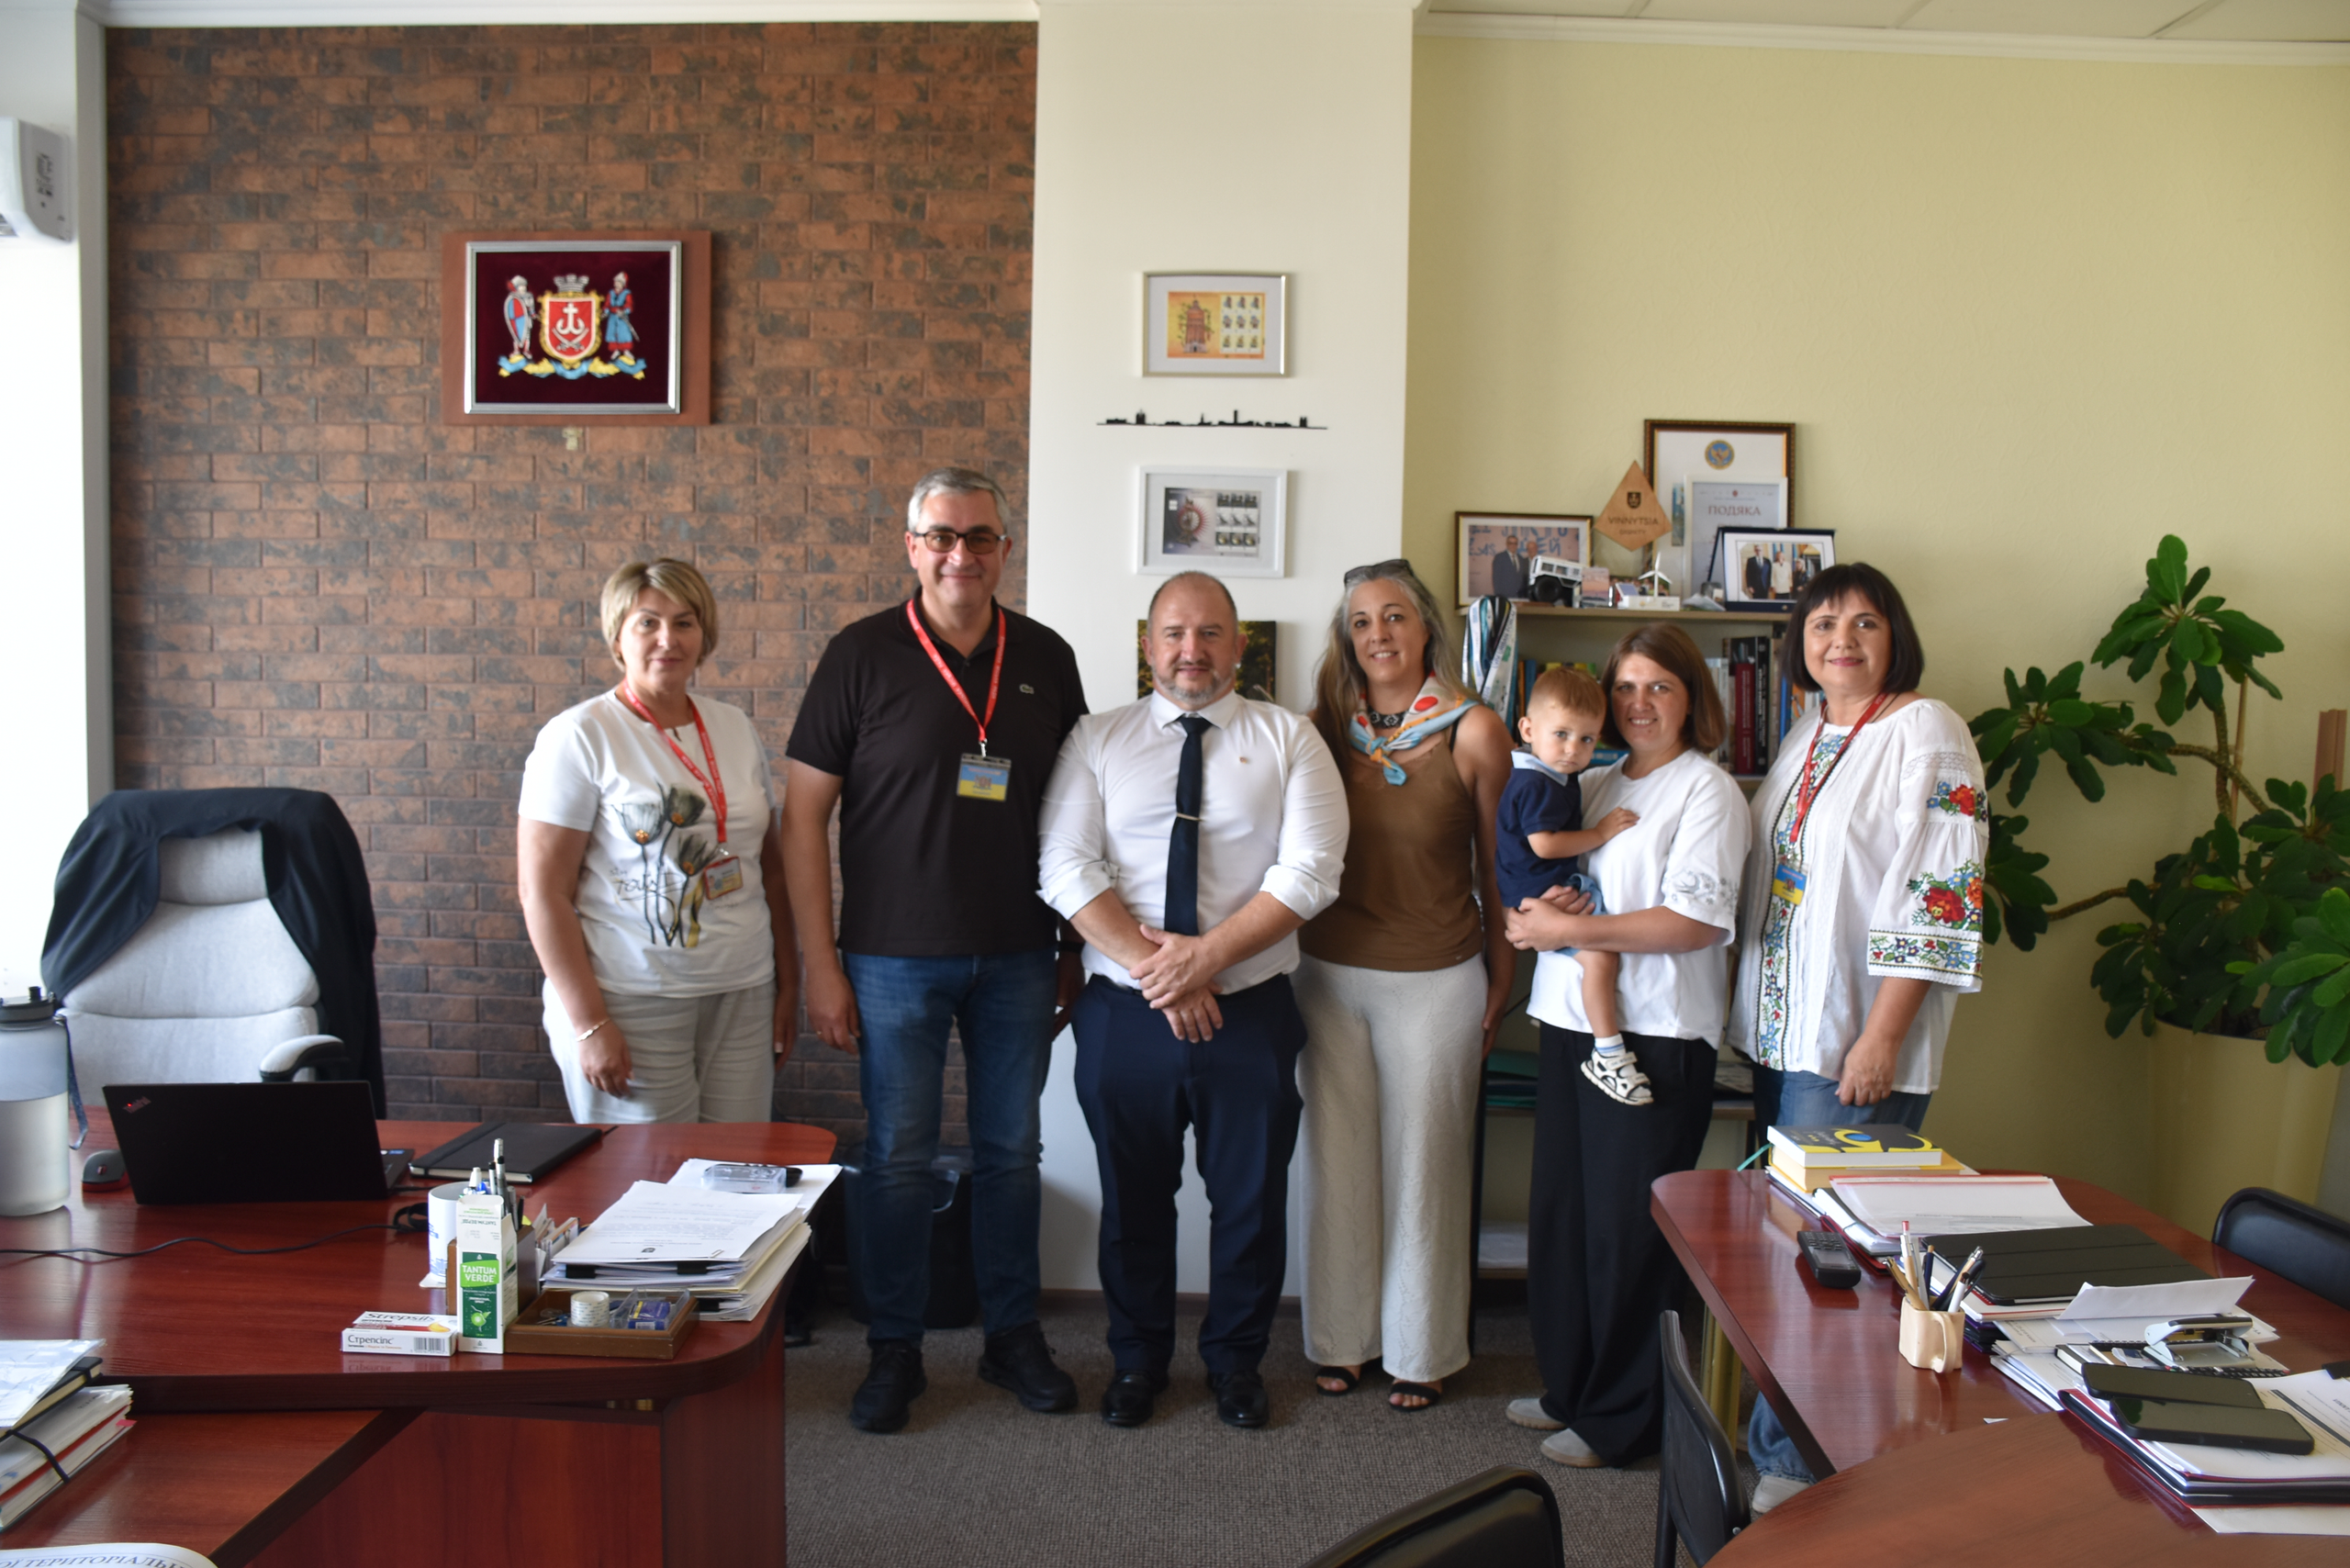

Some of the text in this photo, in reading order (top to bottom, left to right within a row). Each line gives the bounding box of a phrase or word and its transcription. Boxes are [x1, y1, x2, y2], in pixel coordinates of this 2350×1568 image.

[1707, 505, 1762, 516] ПОДЯКА
[1607, 516, 1660, 527] VINNYTSIA
[462, 1264, 498, 1275] TANTUM
[464, 1273, 495, 1283] VERDE
[364, 1313, 435, 1321] Strepsils
[348, 1334, 393, 1344] Стрепсілс
